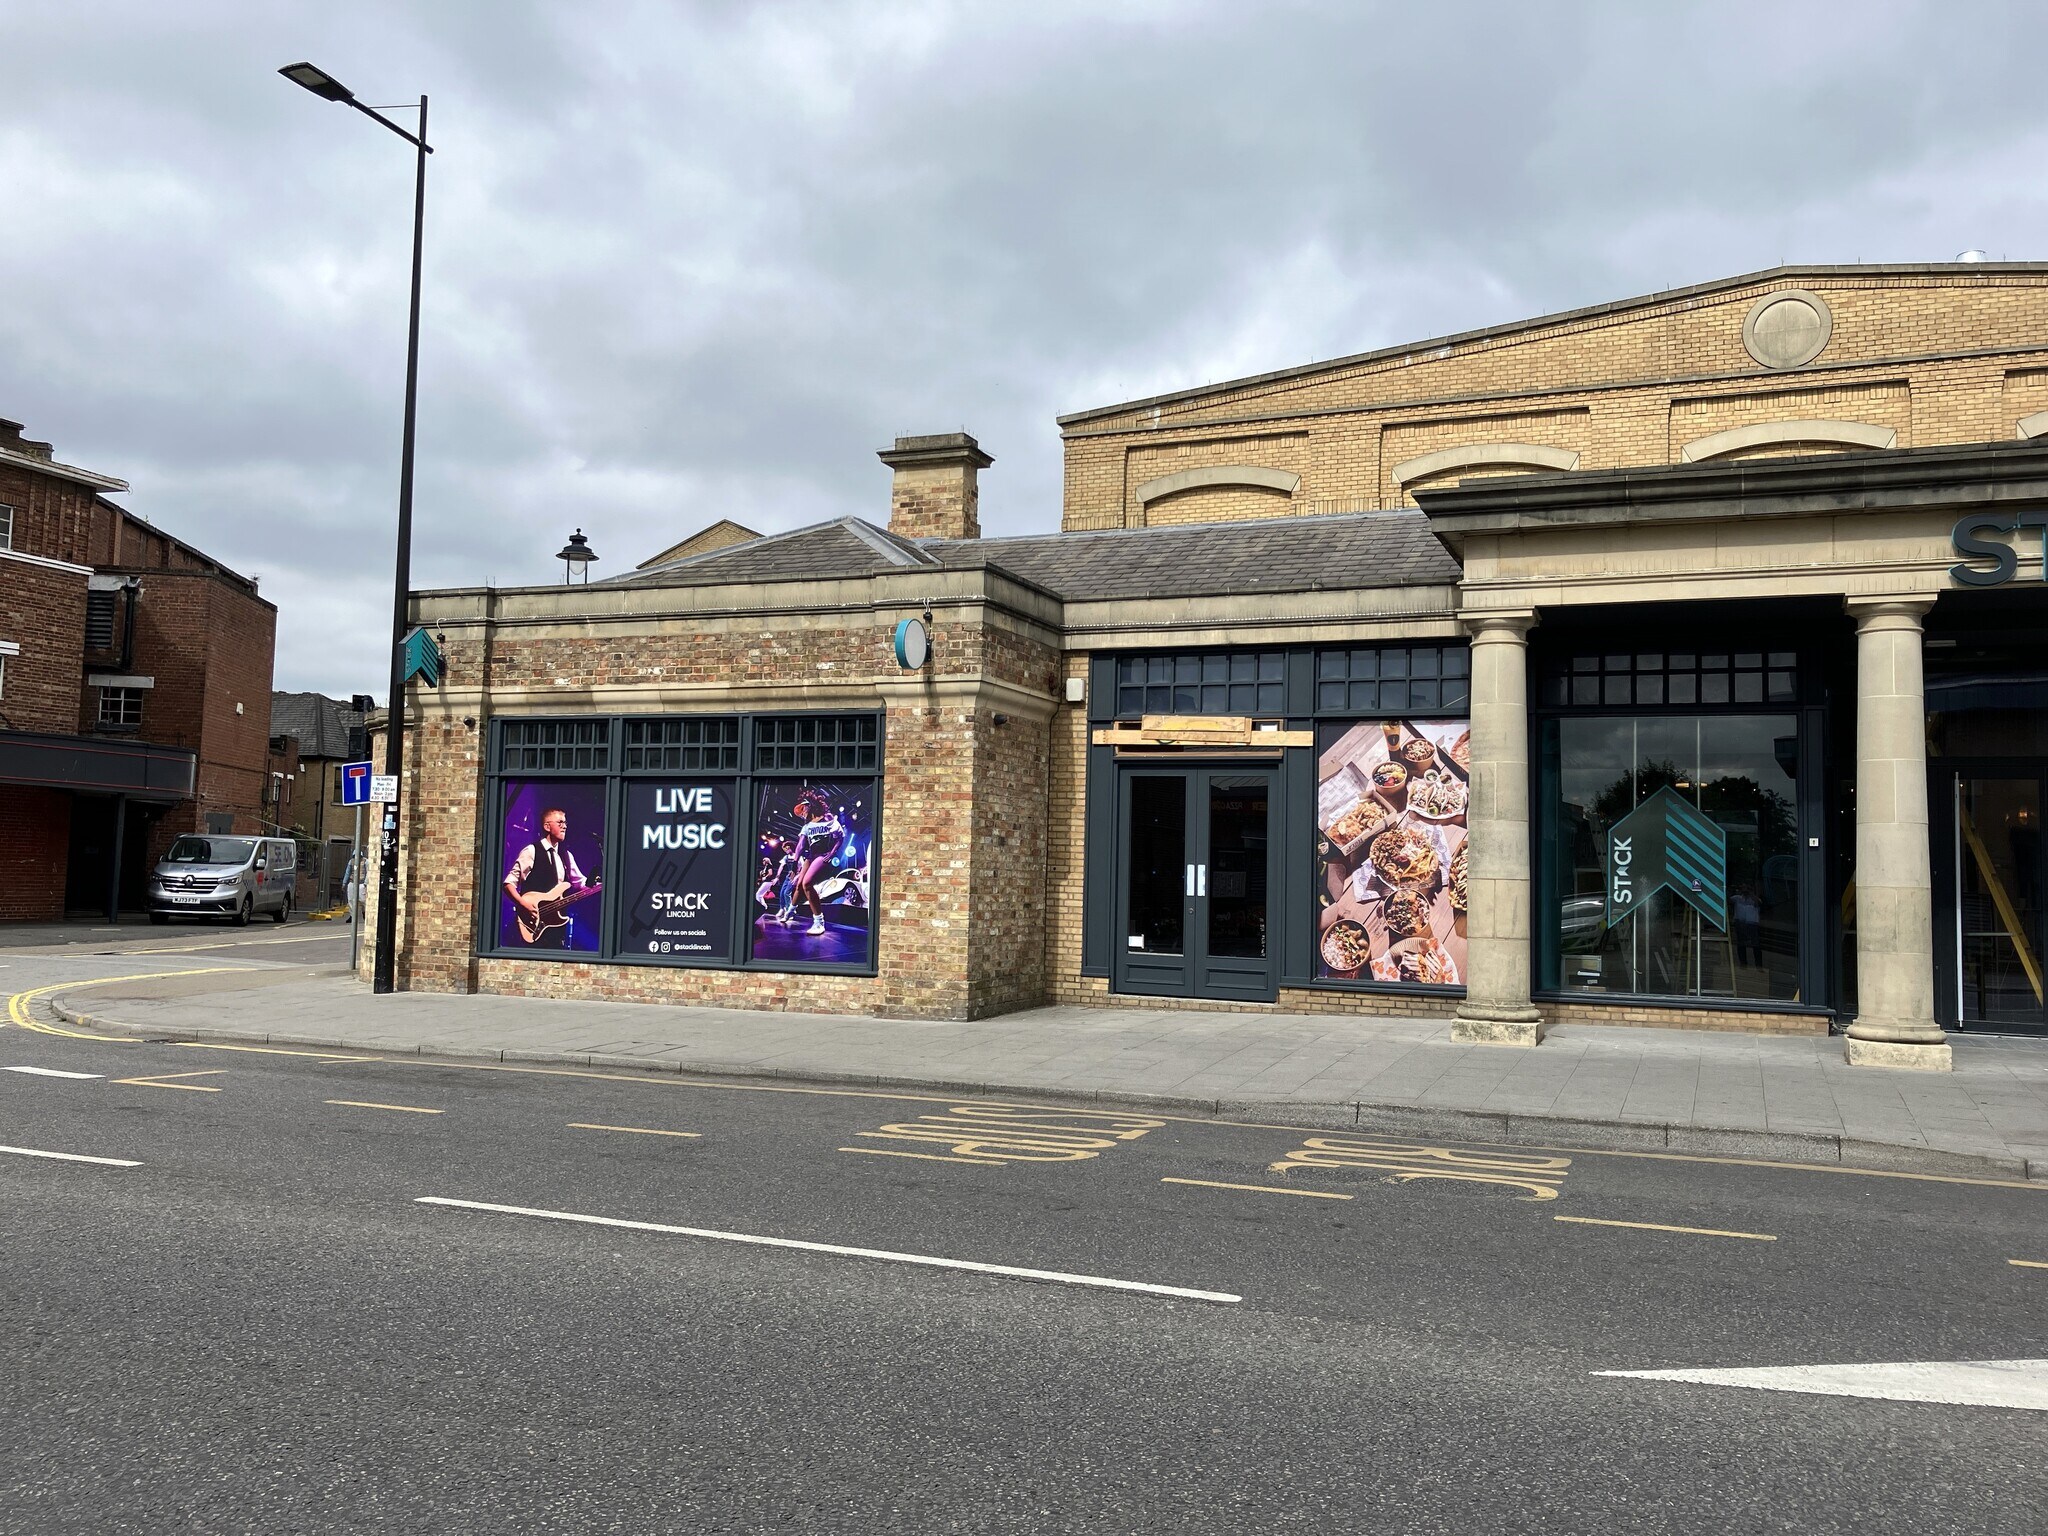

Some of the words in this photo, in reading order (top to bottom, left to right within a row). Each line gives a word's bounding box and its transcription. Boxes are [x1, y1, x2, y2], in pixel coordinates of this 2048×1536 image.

[656, 787, 713, 813] LIVE
[642, 823, 726, 850] MUSIC
[1613, 837, 1633, 904] STACK
[651, 892, 711, 910] STACK
[654, 928, 672, 936] Follow
[855, 1106, 1168, 1163] STOP
